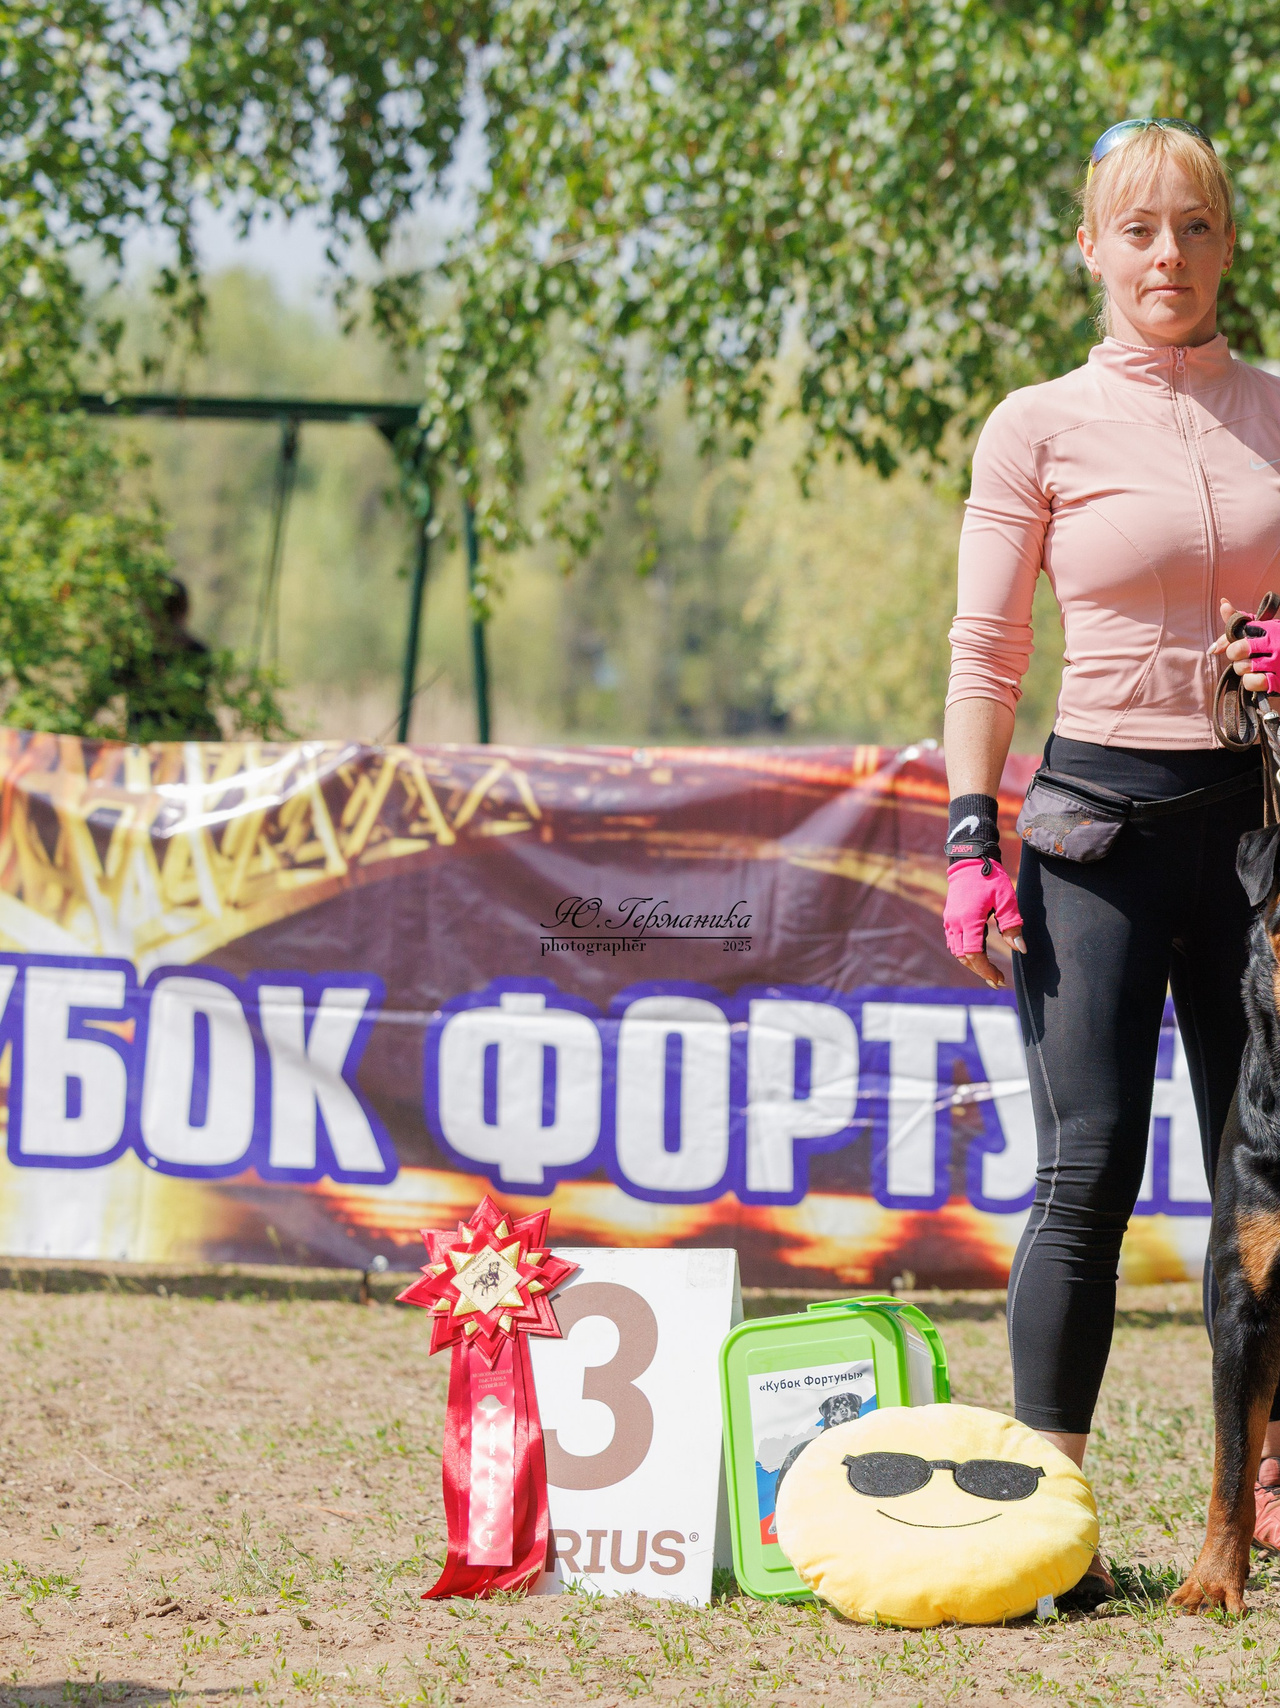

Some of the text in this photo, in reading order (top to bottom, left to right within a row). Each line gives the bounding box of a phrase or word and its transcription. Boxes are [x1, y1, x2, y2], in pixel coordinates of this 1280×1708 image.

[0, 963, 387, 1172] БОК
[540, 1282, 658, 1490] 3
[759, 1372, 863, 1393] «Кубок Фортуны»
